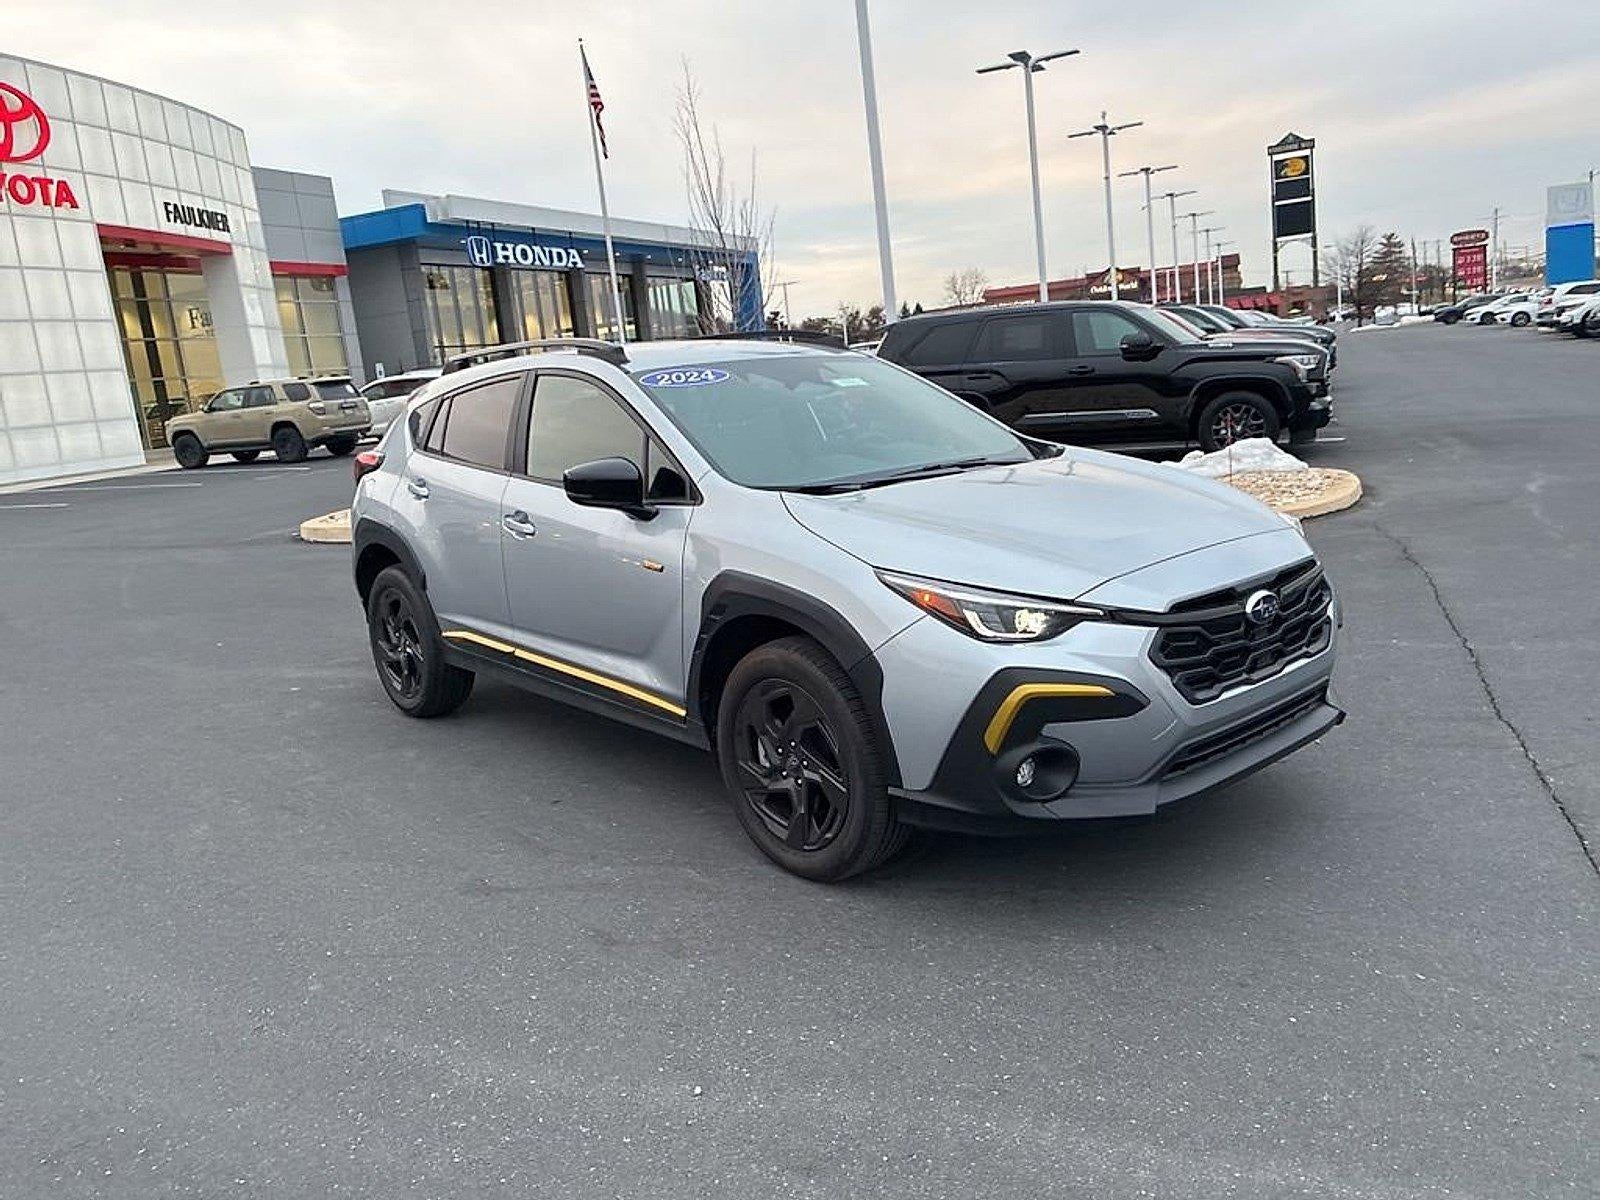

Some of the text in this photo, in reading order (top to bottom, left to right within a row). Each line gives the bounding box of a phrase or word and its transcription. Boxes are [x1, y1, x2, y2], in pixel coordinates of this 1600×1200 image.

[0, 173, 79, 209] OTA
[163, 201, 231, 233] FAULKNER
[492, 242, 585, 268] HONDA
[656, 369, 716, 386] 2024
